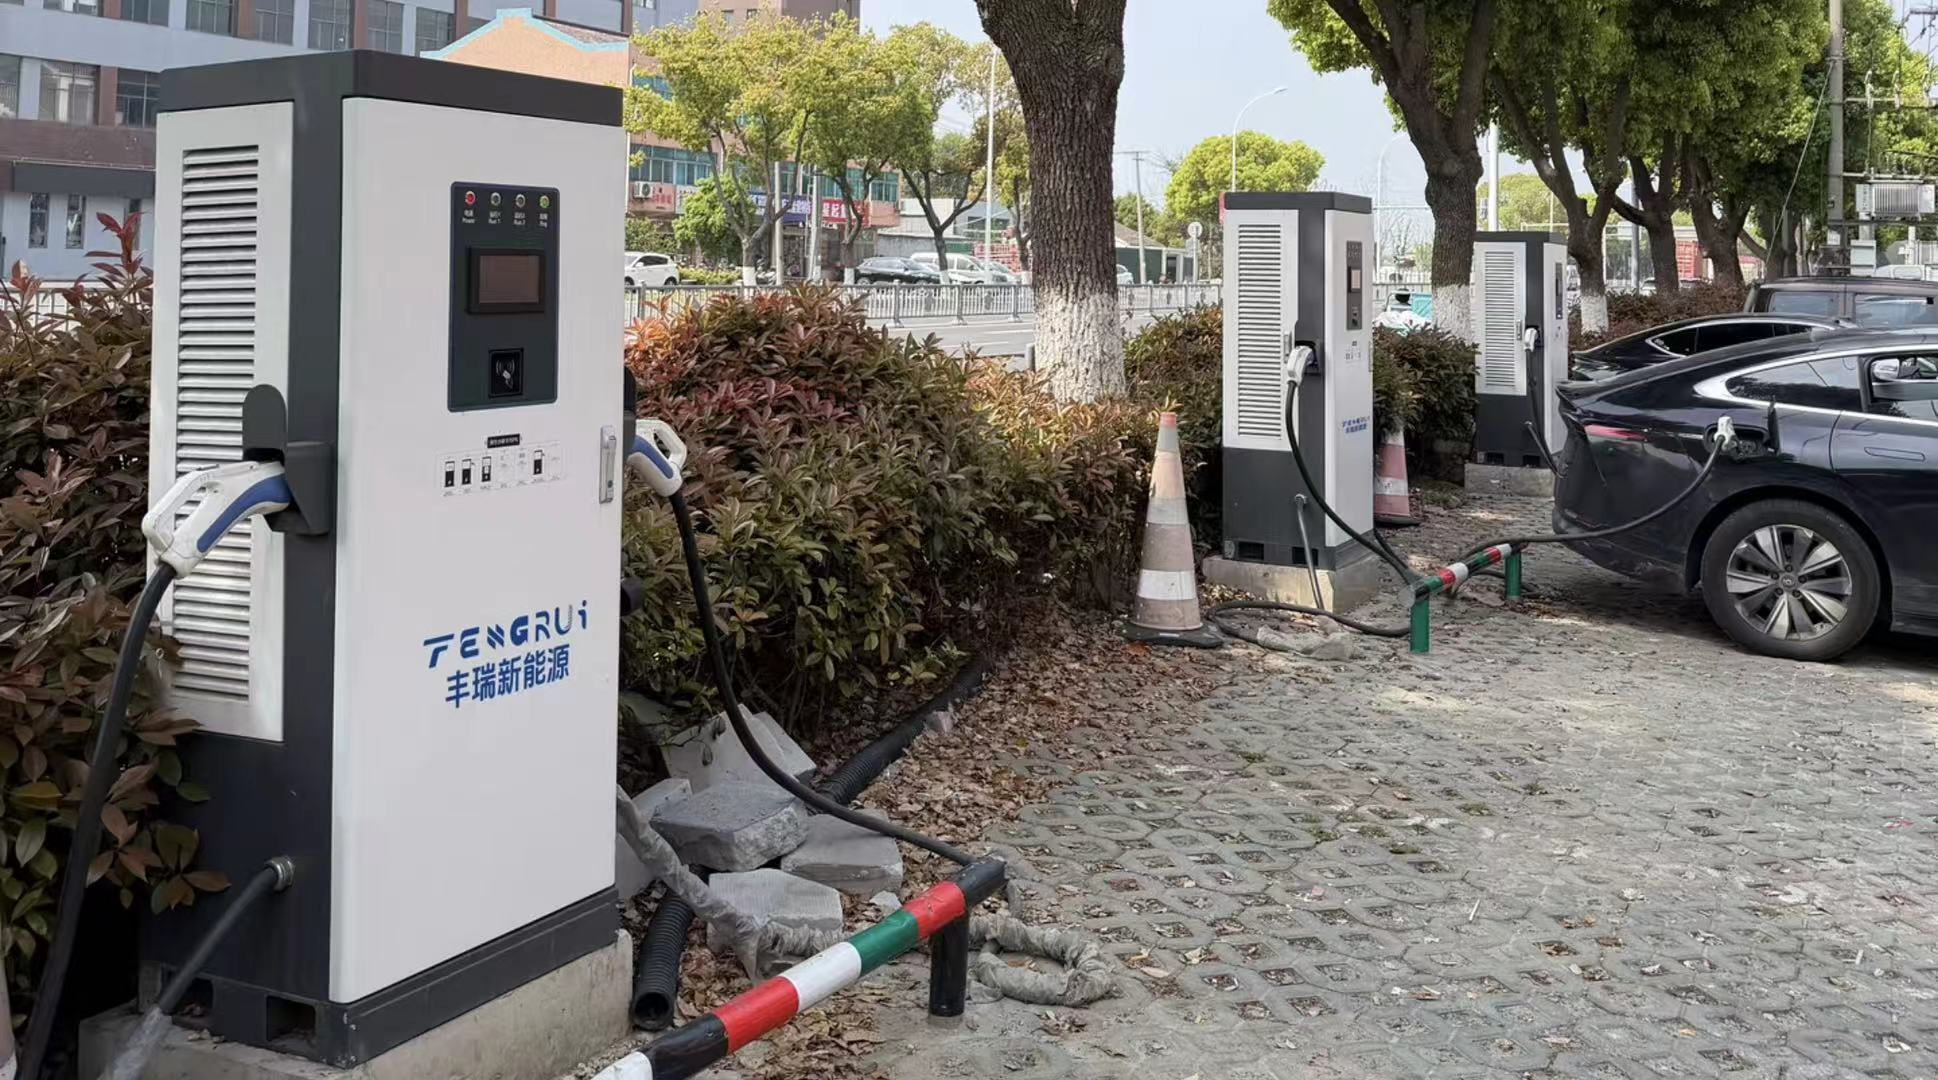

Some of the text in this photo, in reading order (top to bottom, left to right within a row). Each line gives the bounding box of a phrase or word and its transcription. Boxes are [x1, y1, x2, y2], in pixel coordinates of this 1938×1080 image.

[445, 643, 571, 708] 丰瑞新能源
